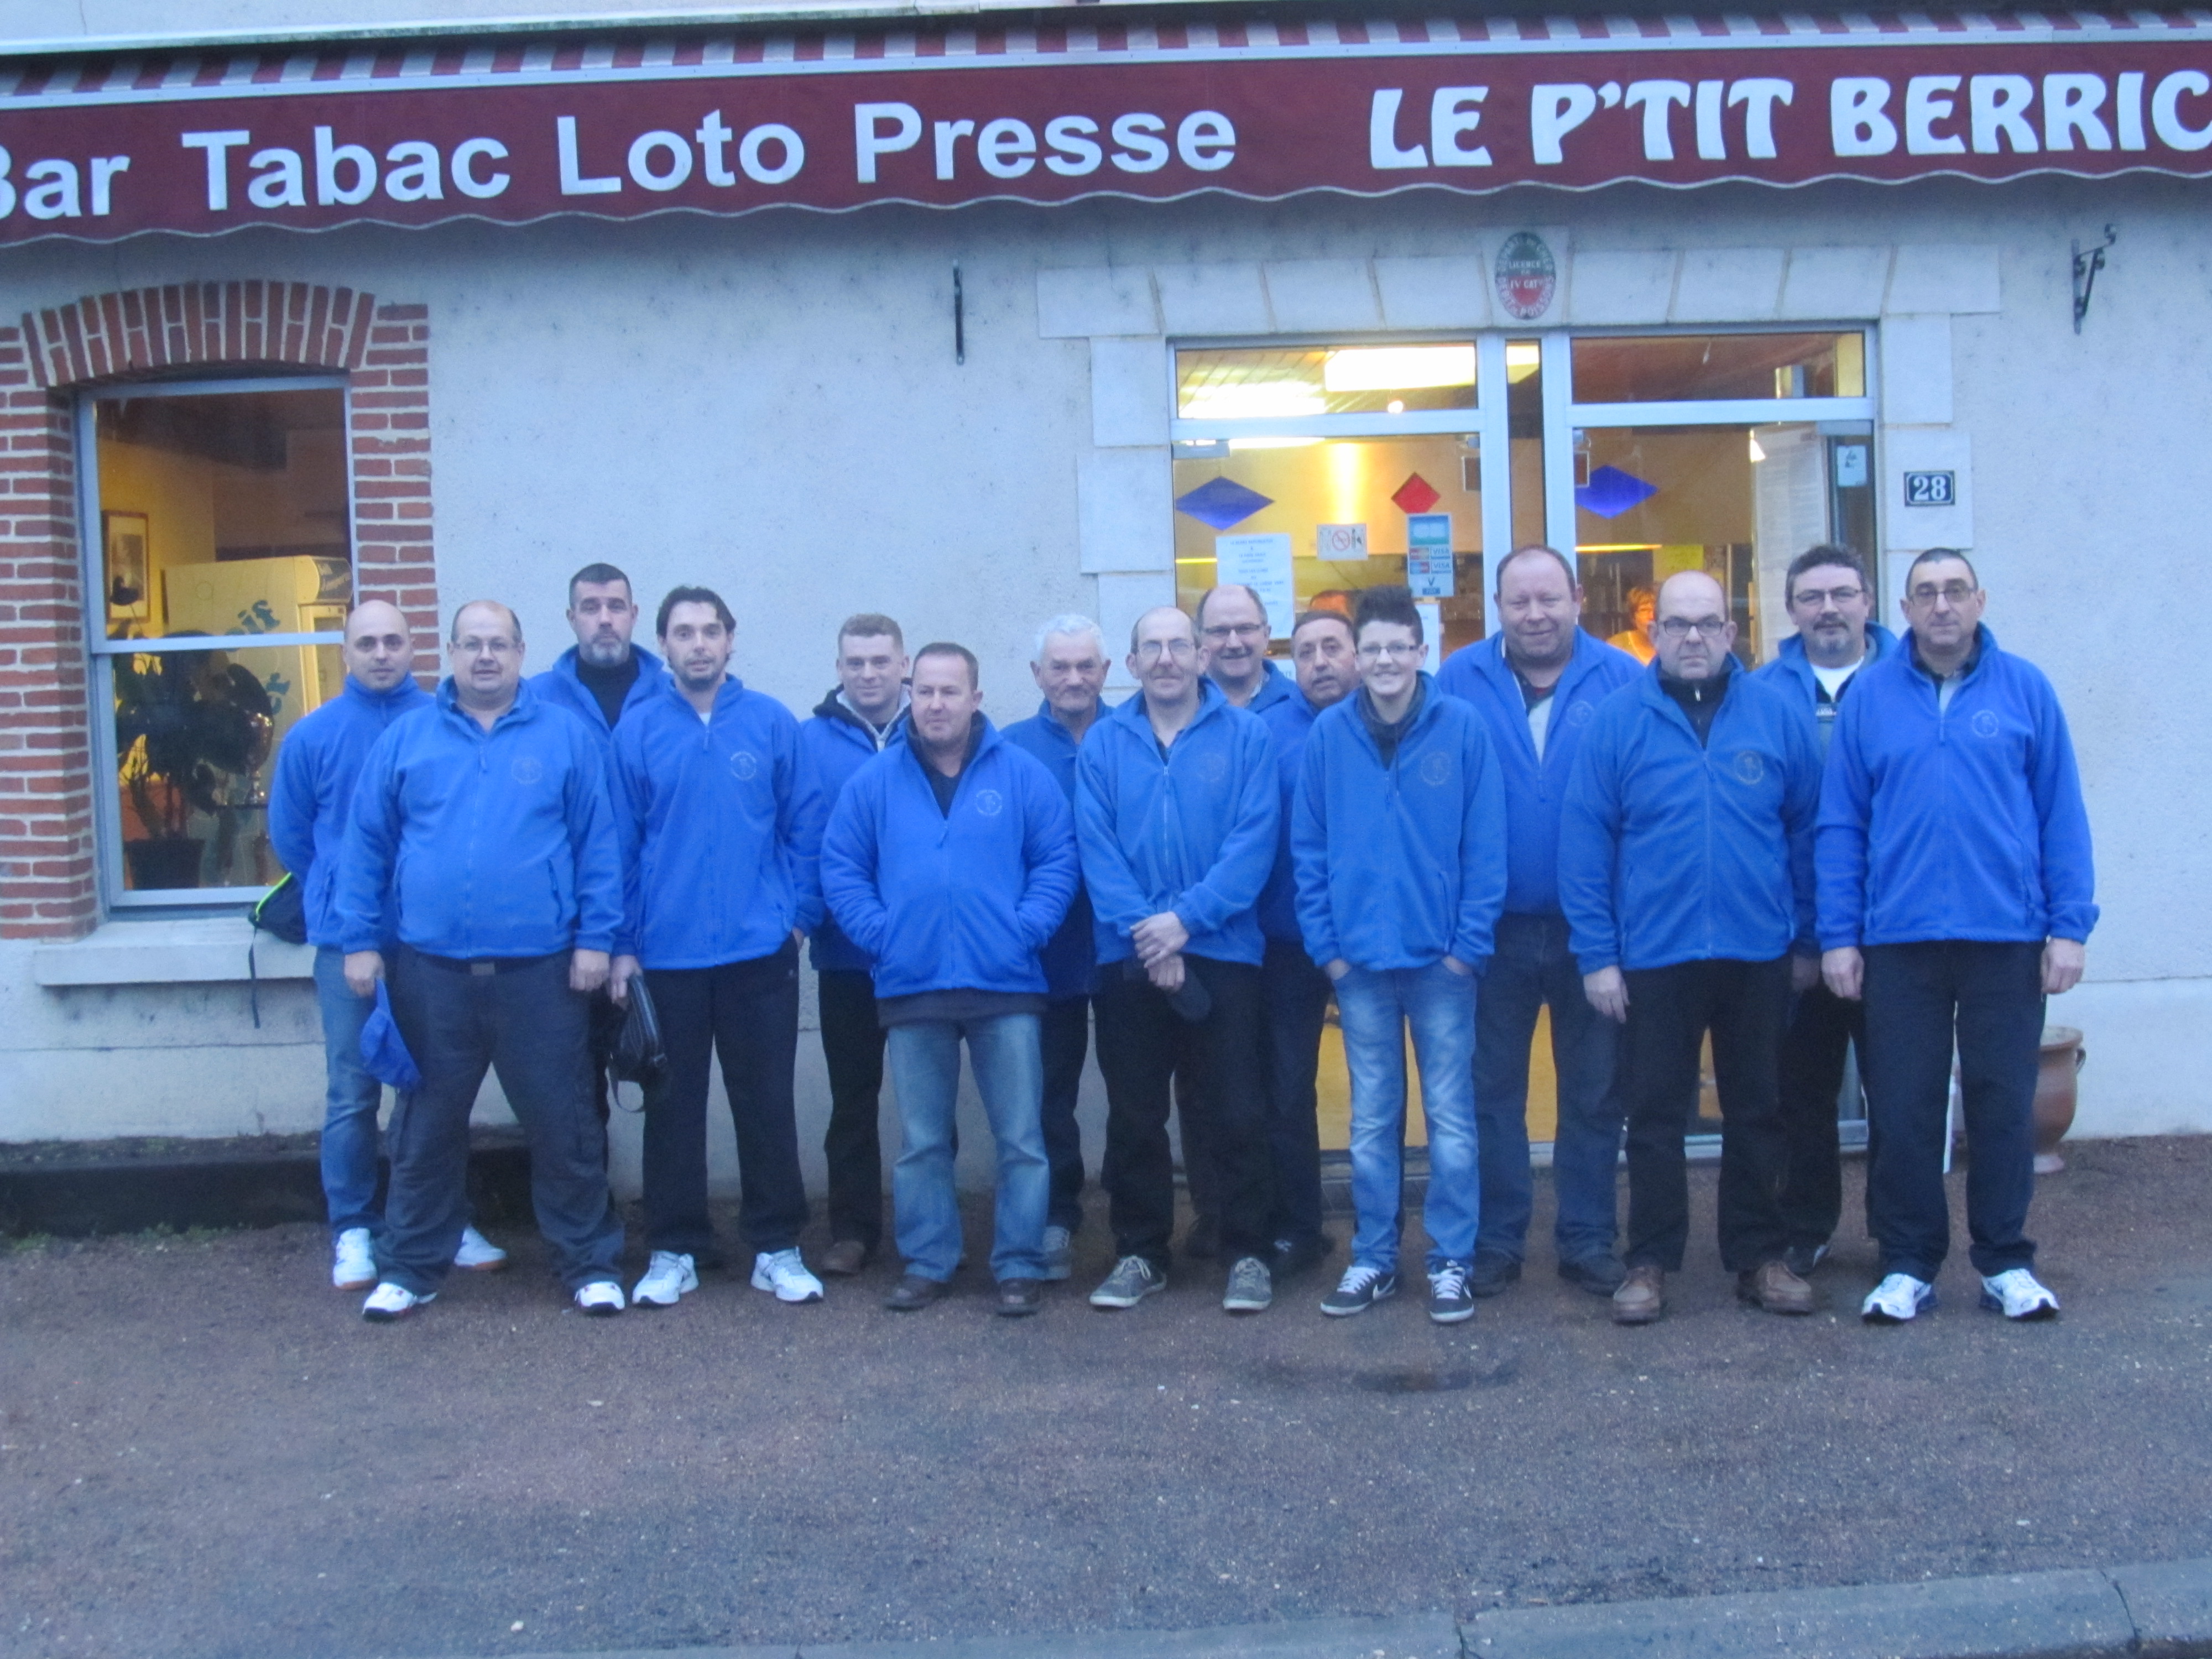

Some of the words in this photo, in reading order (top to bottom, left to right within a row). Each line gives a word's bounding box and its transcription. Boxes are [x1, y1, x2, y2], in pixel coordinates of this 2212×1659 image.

[1370, 86, 1493, 170] LE
[1531, 77, 1794, 165] P'TIT
[1830, 70, 2212, 157] BERRIC
[0, 145, 131, 220] ar
[182, 126, 510, 211] Tabac
[557, 109, 805, 195] Loto
[855, 102, 1236, 184] Presse
[1509, 260, 1541, 269] LICENCE
[1914, 476, 1946, 500] 28
